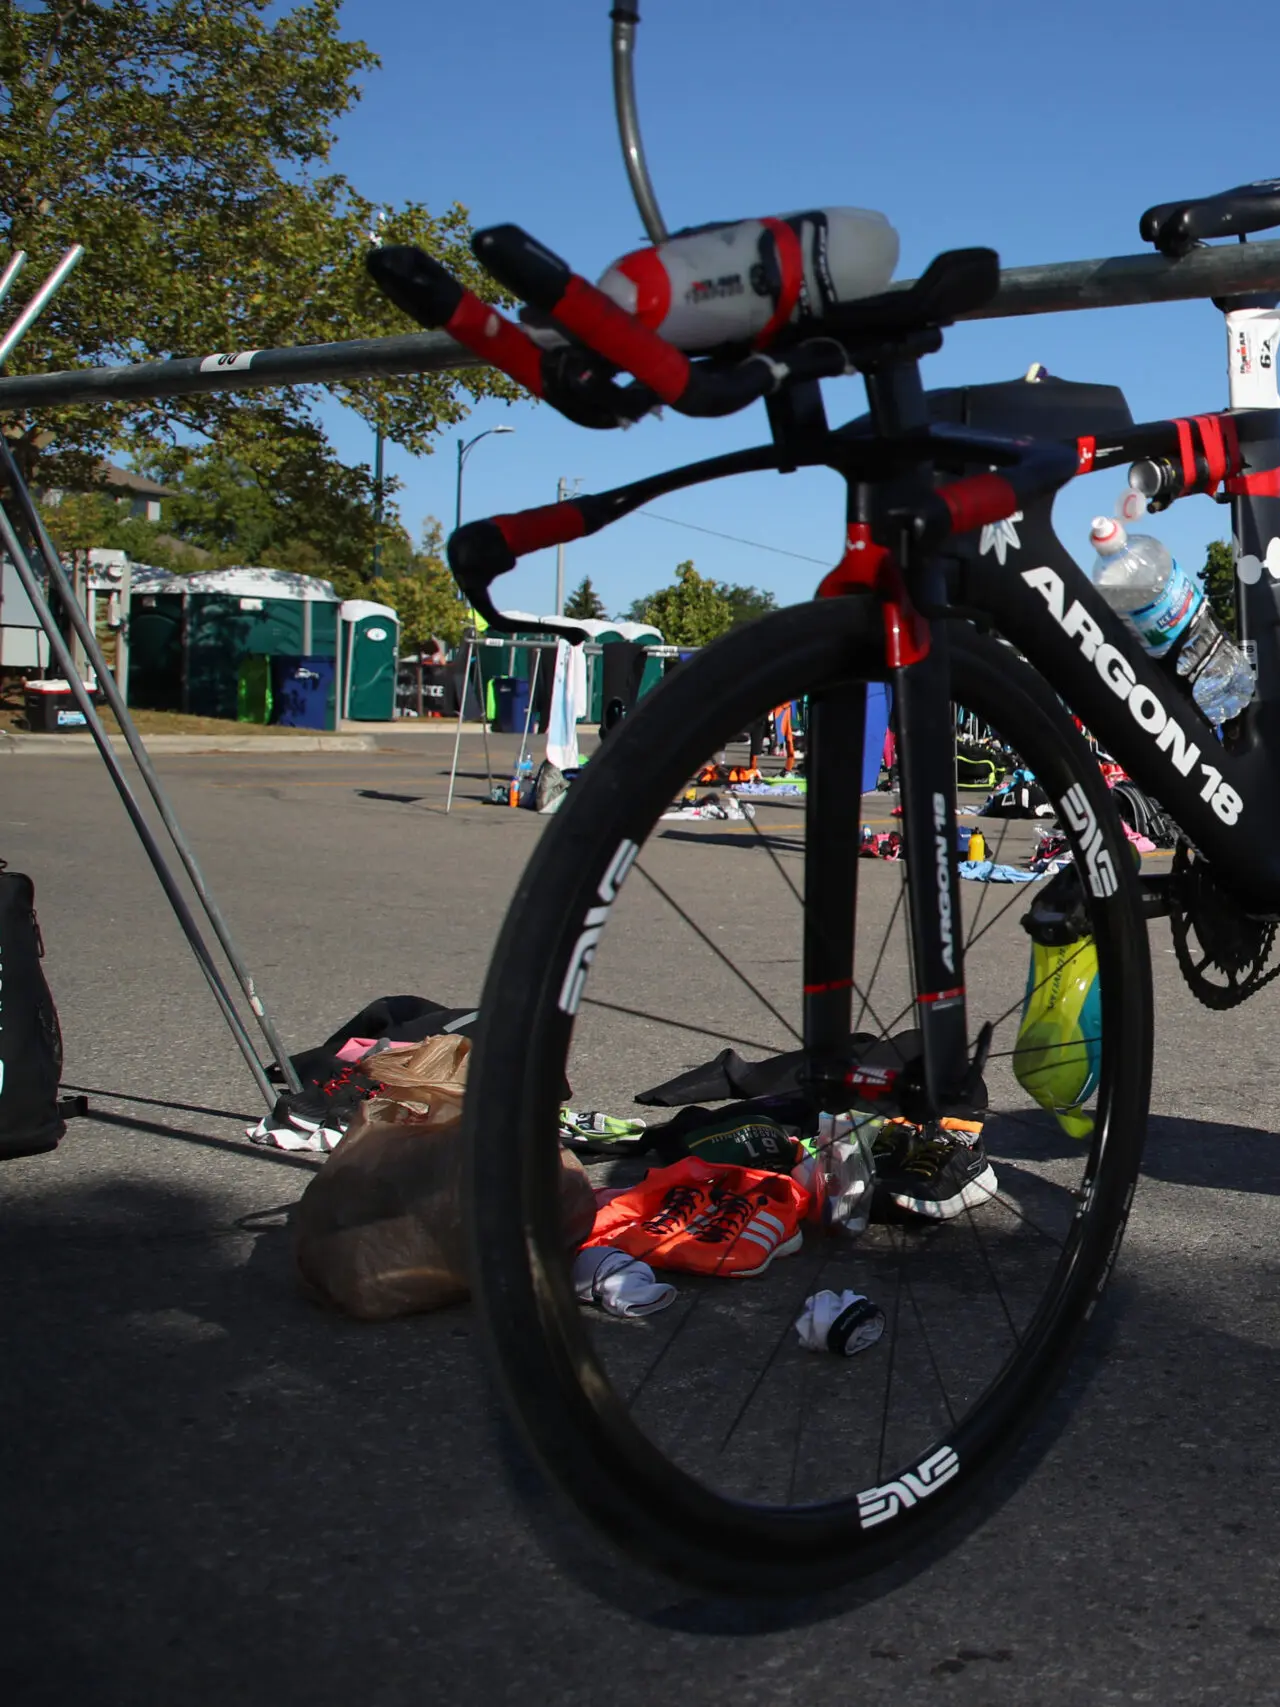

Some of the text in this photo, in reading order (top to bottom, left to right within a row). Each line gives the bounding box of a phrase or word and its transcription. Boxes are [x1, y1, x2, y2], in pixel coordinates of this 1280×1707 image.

[1020, 566, 1244, 827] ARGON 18
[935, 835, 955, 974] ARGON
